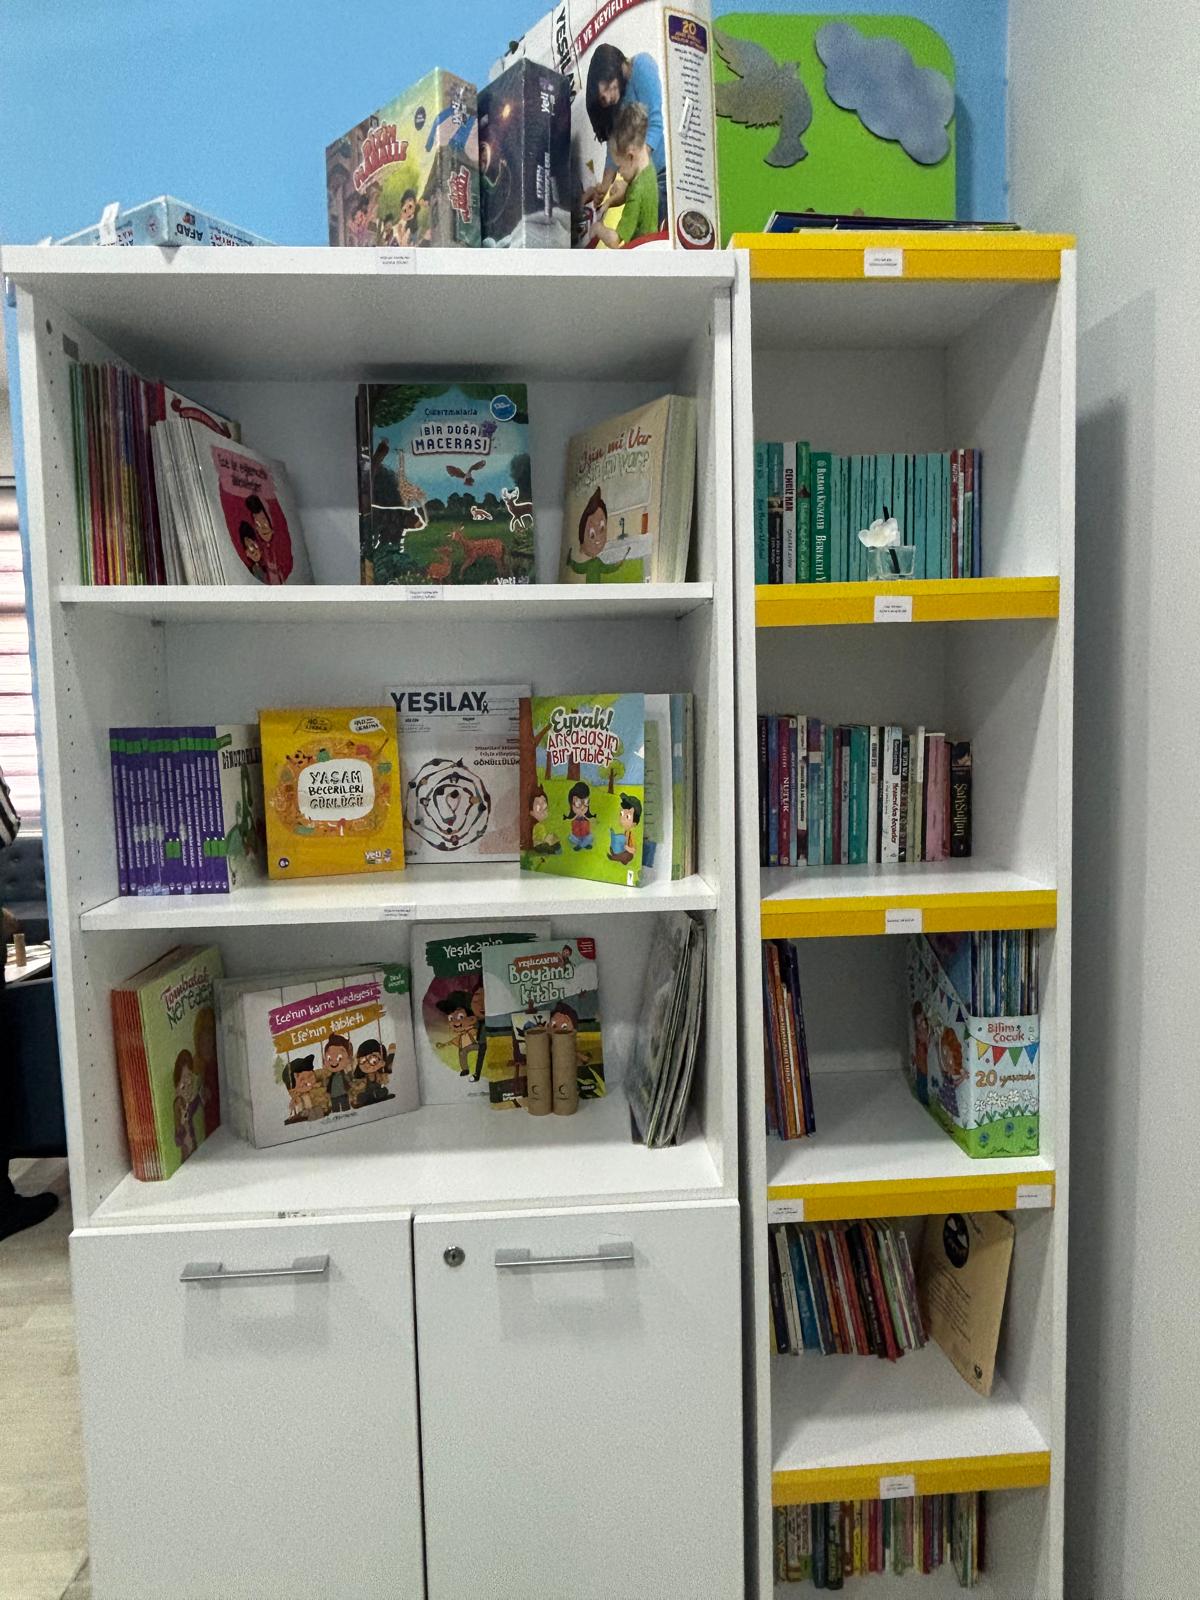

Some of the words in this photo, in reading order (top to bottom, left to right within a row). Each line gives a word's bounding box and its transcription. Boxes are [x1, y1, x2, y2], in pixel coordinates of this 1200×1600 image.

[682, 20, 697, 35] 20
[176, 222, 203, 242] AFAD
[447, 424, 477, 436] DOĞA
[415, 437, 487, 451] MACERASI
[390, 691, 487, 714] YEŞİLAY
[309, 770, 363, 785] YAŞAM
[782, 776, 790, 813] NUTUK
[509, 963, 574, 985] Boyama
[520, 981, 567, 1007] kitabı
[975, 1069, 998, 1088] 20
